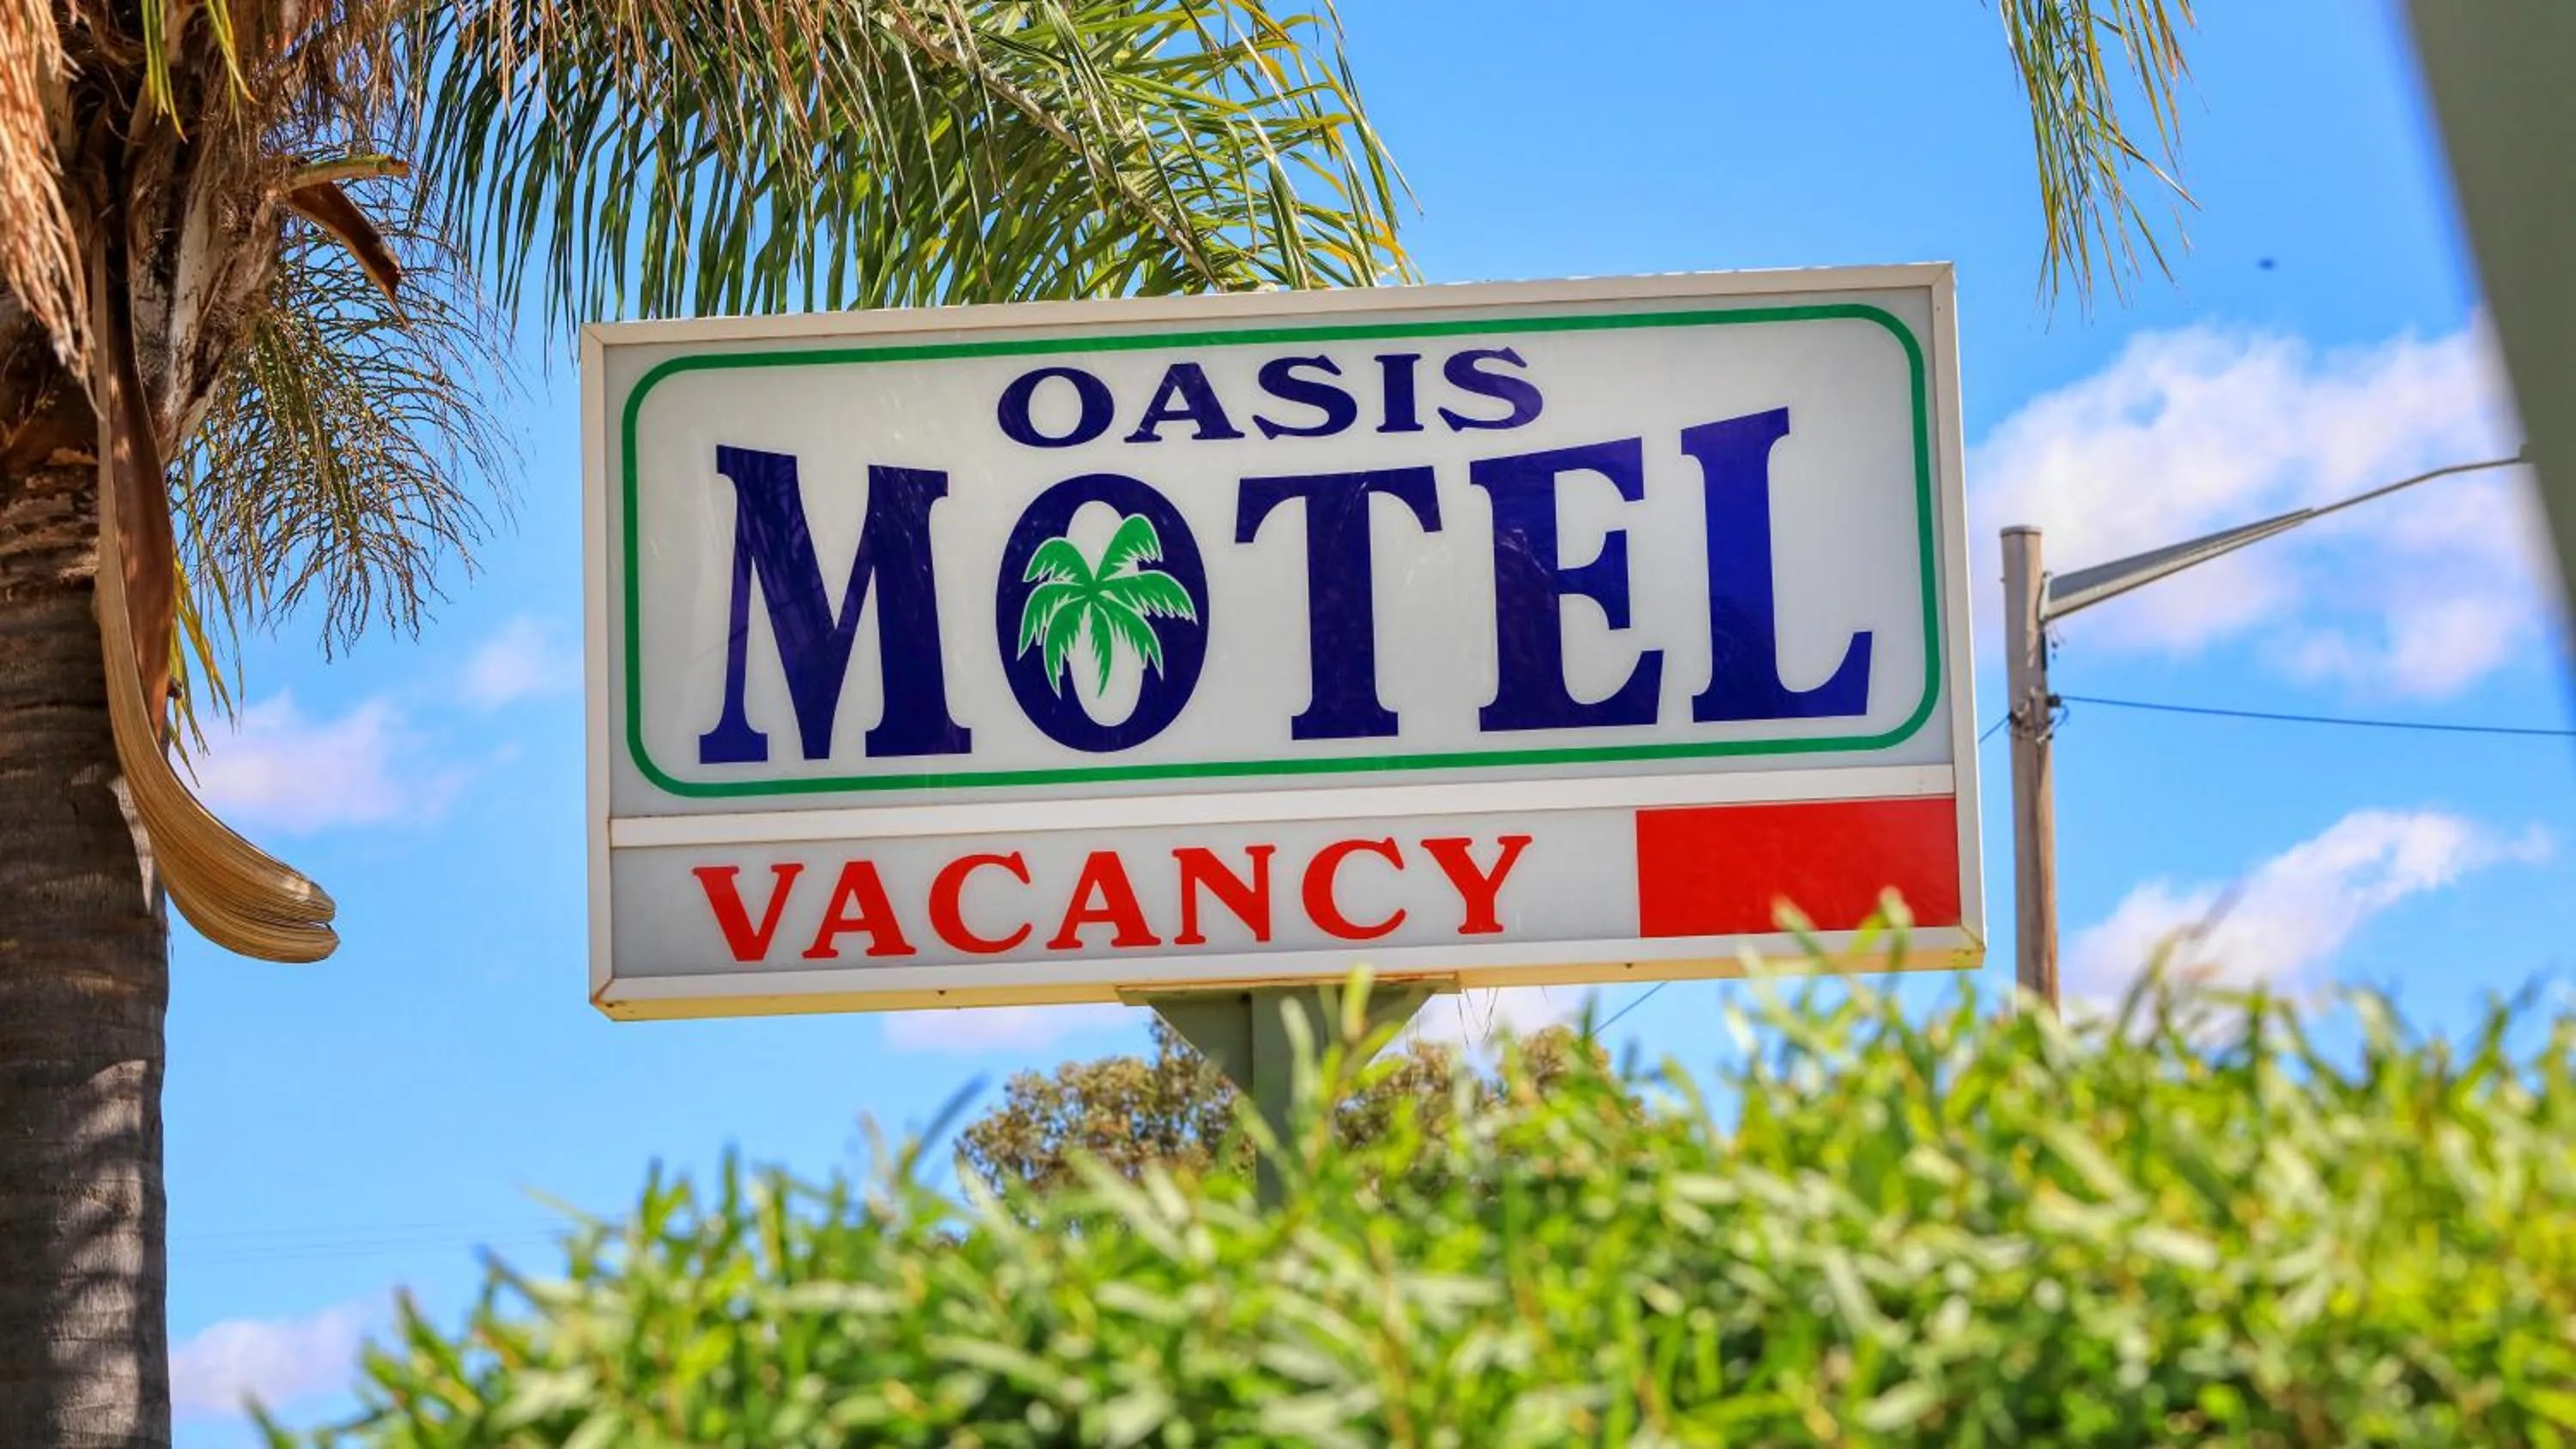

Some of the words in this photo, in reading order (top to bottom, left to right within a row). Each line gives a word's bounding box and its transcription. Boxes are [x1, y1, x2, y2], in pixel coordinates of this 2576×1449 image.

[998, 347, 1542, 448] OASIS
[699, 407, 1872, 764] MOTEL
[692, 835, 1532, 962] VACANCY
